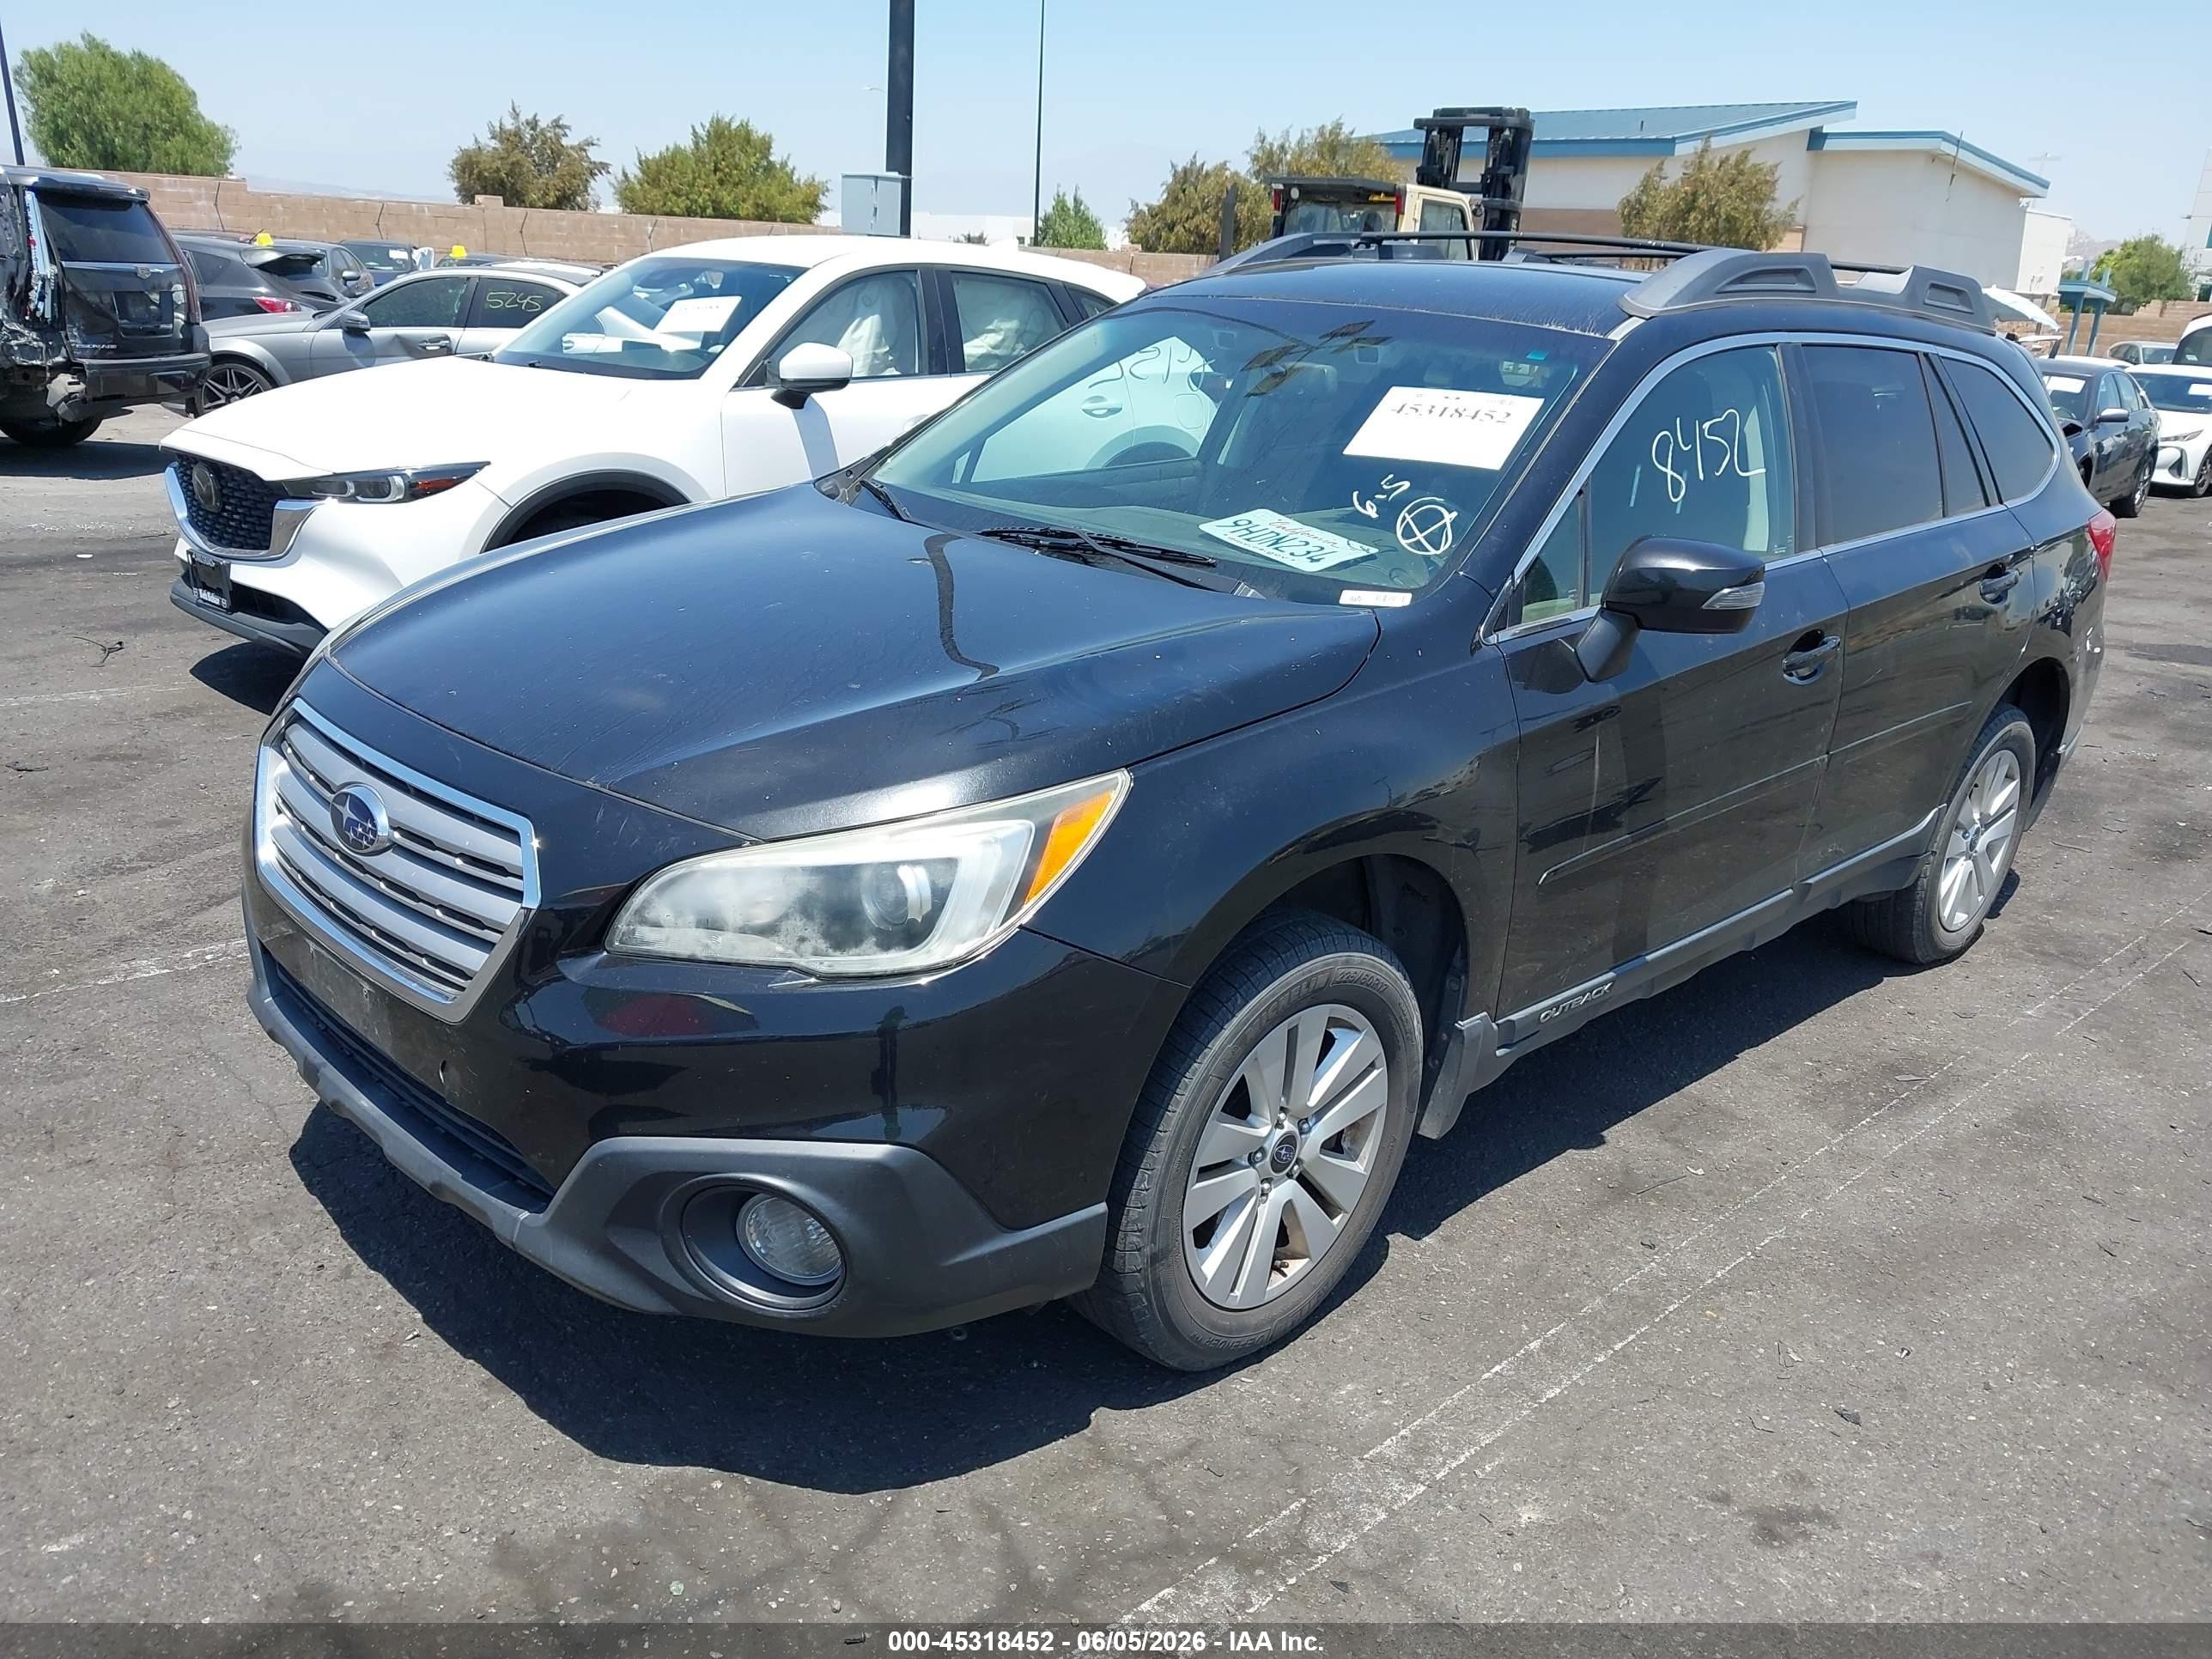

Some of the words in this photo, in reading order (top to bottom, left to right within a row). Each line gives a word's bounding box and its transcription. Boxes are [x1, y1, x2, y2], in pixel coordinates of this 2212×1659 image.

[486, 291, 544, 313] 5245
[1390, 402, 1512, 424] 45318452
[1652, 409, 1767, 502] 8452
[1216, 519, 1338, 563] 9HDN234
[1268, 518, 1340, 550] California
[1540, 982, 1613, 1023] OUTBACK
